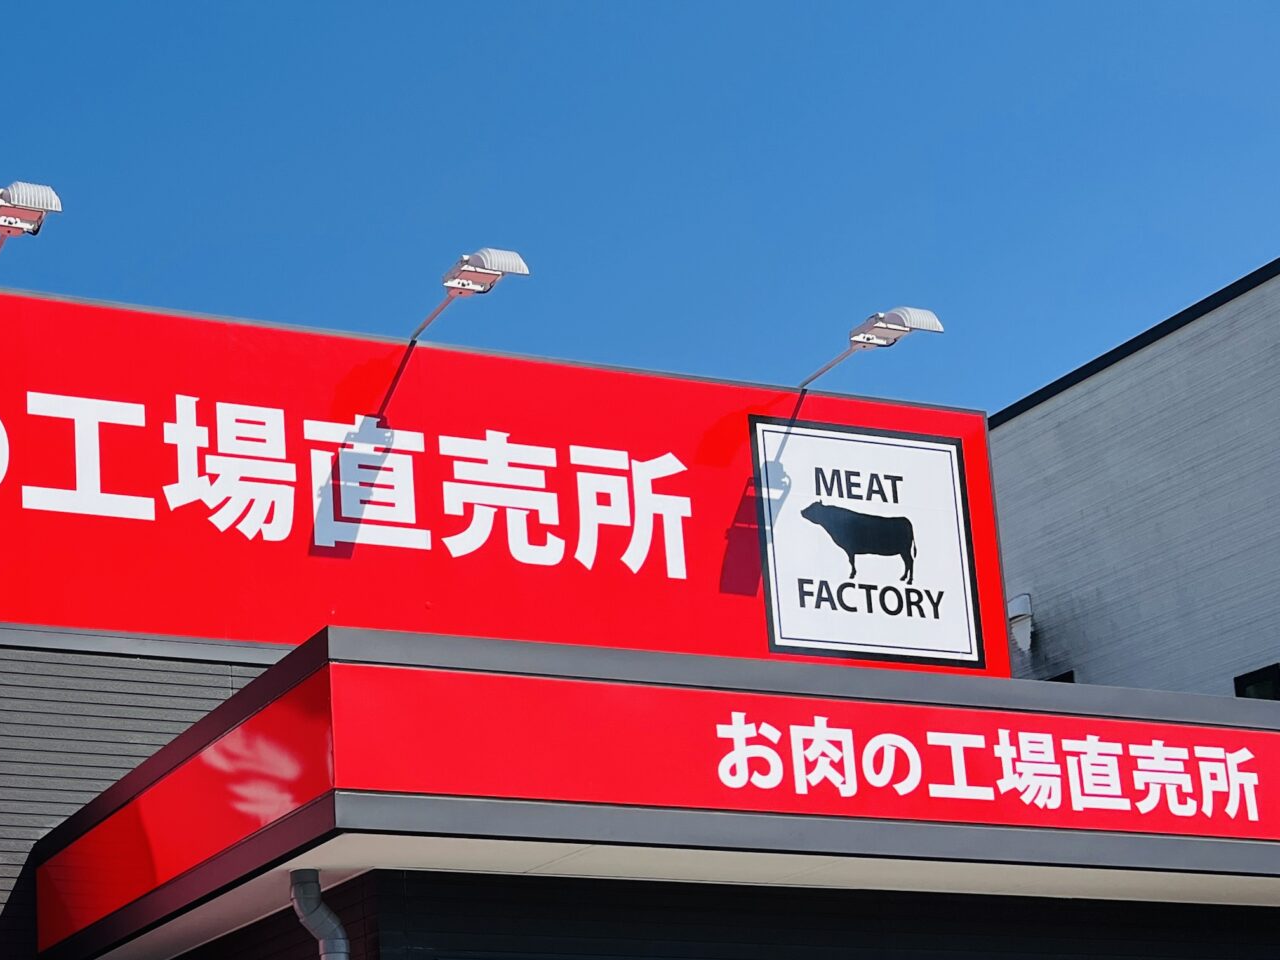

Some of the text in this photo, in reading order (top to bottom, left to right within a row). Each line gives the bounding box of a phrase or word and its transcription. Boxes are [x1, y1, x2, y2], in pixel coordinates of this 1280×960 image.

[813, 465, 903, 506] MEAT
[796, 577, 945, 621] FACTORY
[715, 711, 1260, 822] お肉の工場直売所
